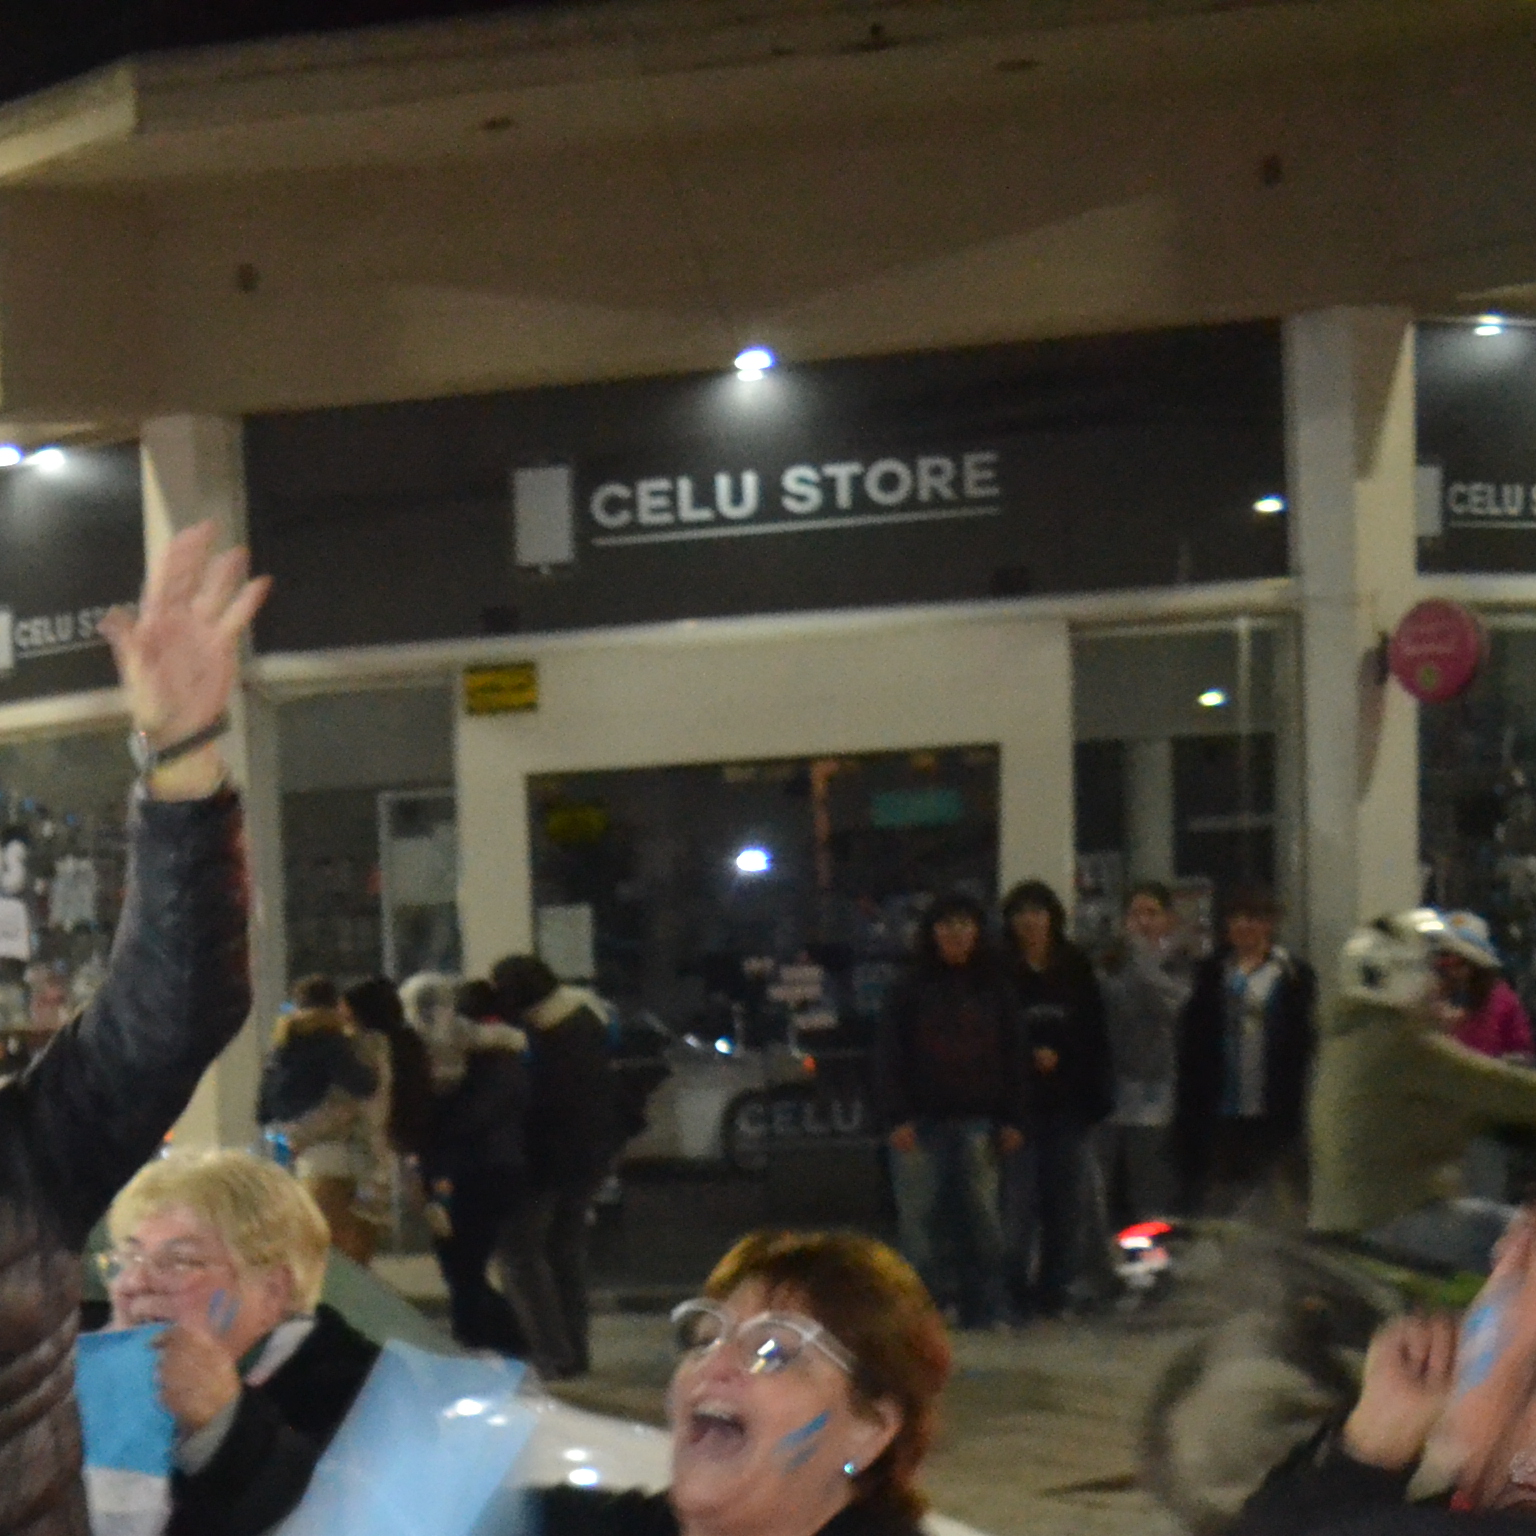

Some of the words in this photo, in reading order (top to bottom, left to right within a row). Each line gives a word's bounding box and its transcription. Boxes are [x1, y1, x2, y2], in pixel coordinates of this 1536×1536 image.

[589, 469, 760, 528] CELU
[781, 452, 1001, 514] STORE
[1449, 481, 1524, 515] CELU
